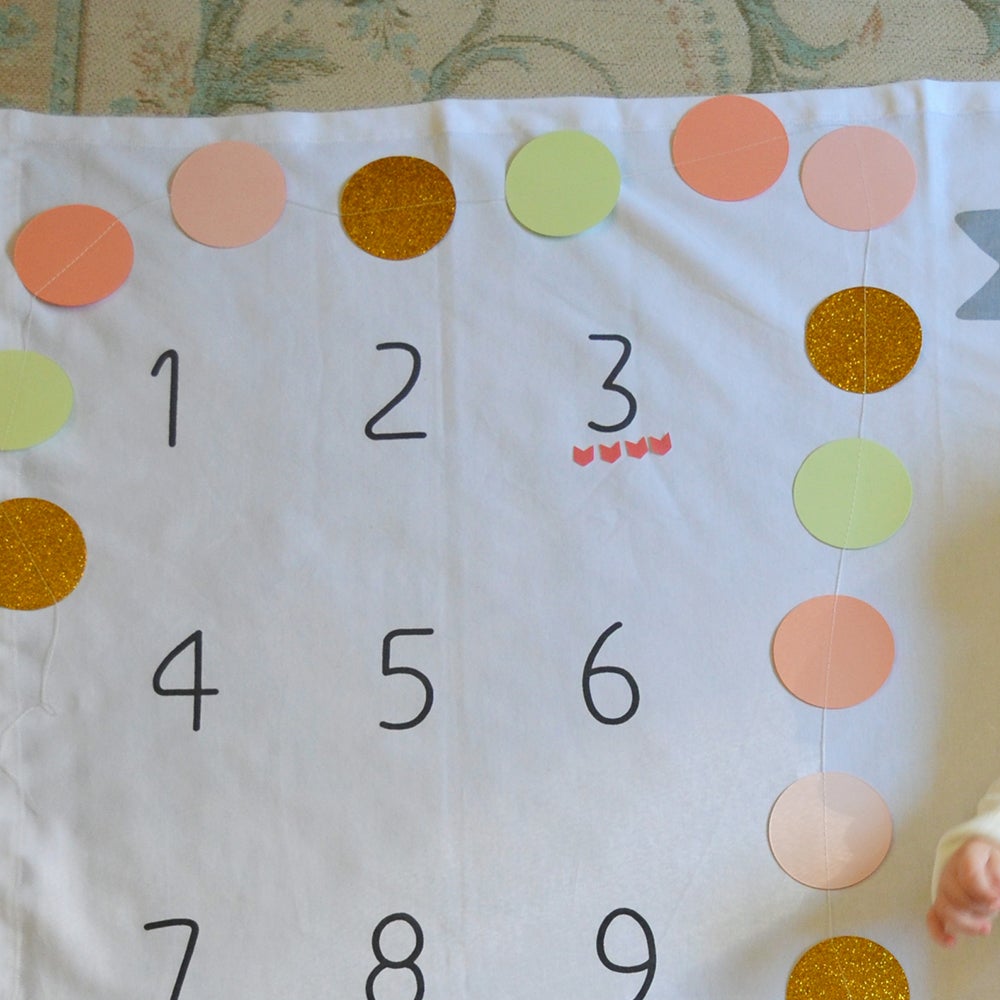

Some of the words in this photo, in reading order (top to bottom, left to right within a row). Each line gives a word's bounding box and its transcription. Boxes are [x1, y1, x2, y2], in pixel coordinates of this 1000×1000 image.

[150, 348, 179, 448] 1
[364, 341, 427, 441] 2
[587, 334, 637, 433] 3
[152, 629, 220, 732] 4
[379, 628, 435, 731] 5
[581, 621, 640, 726] 6
